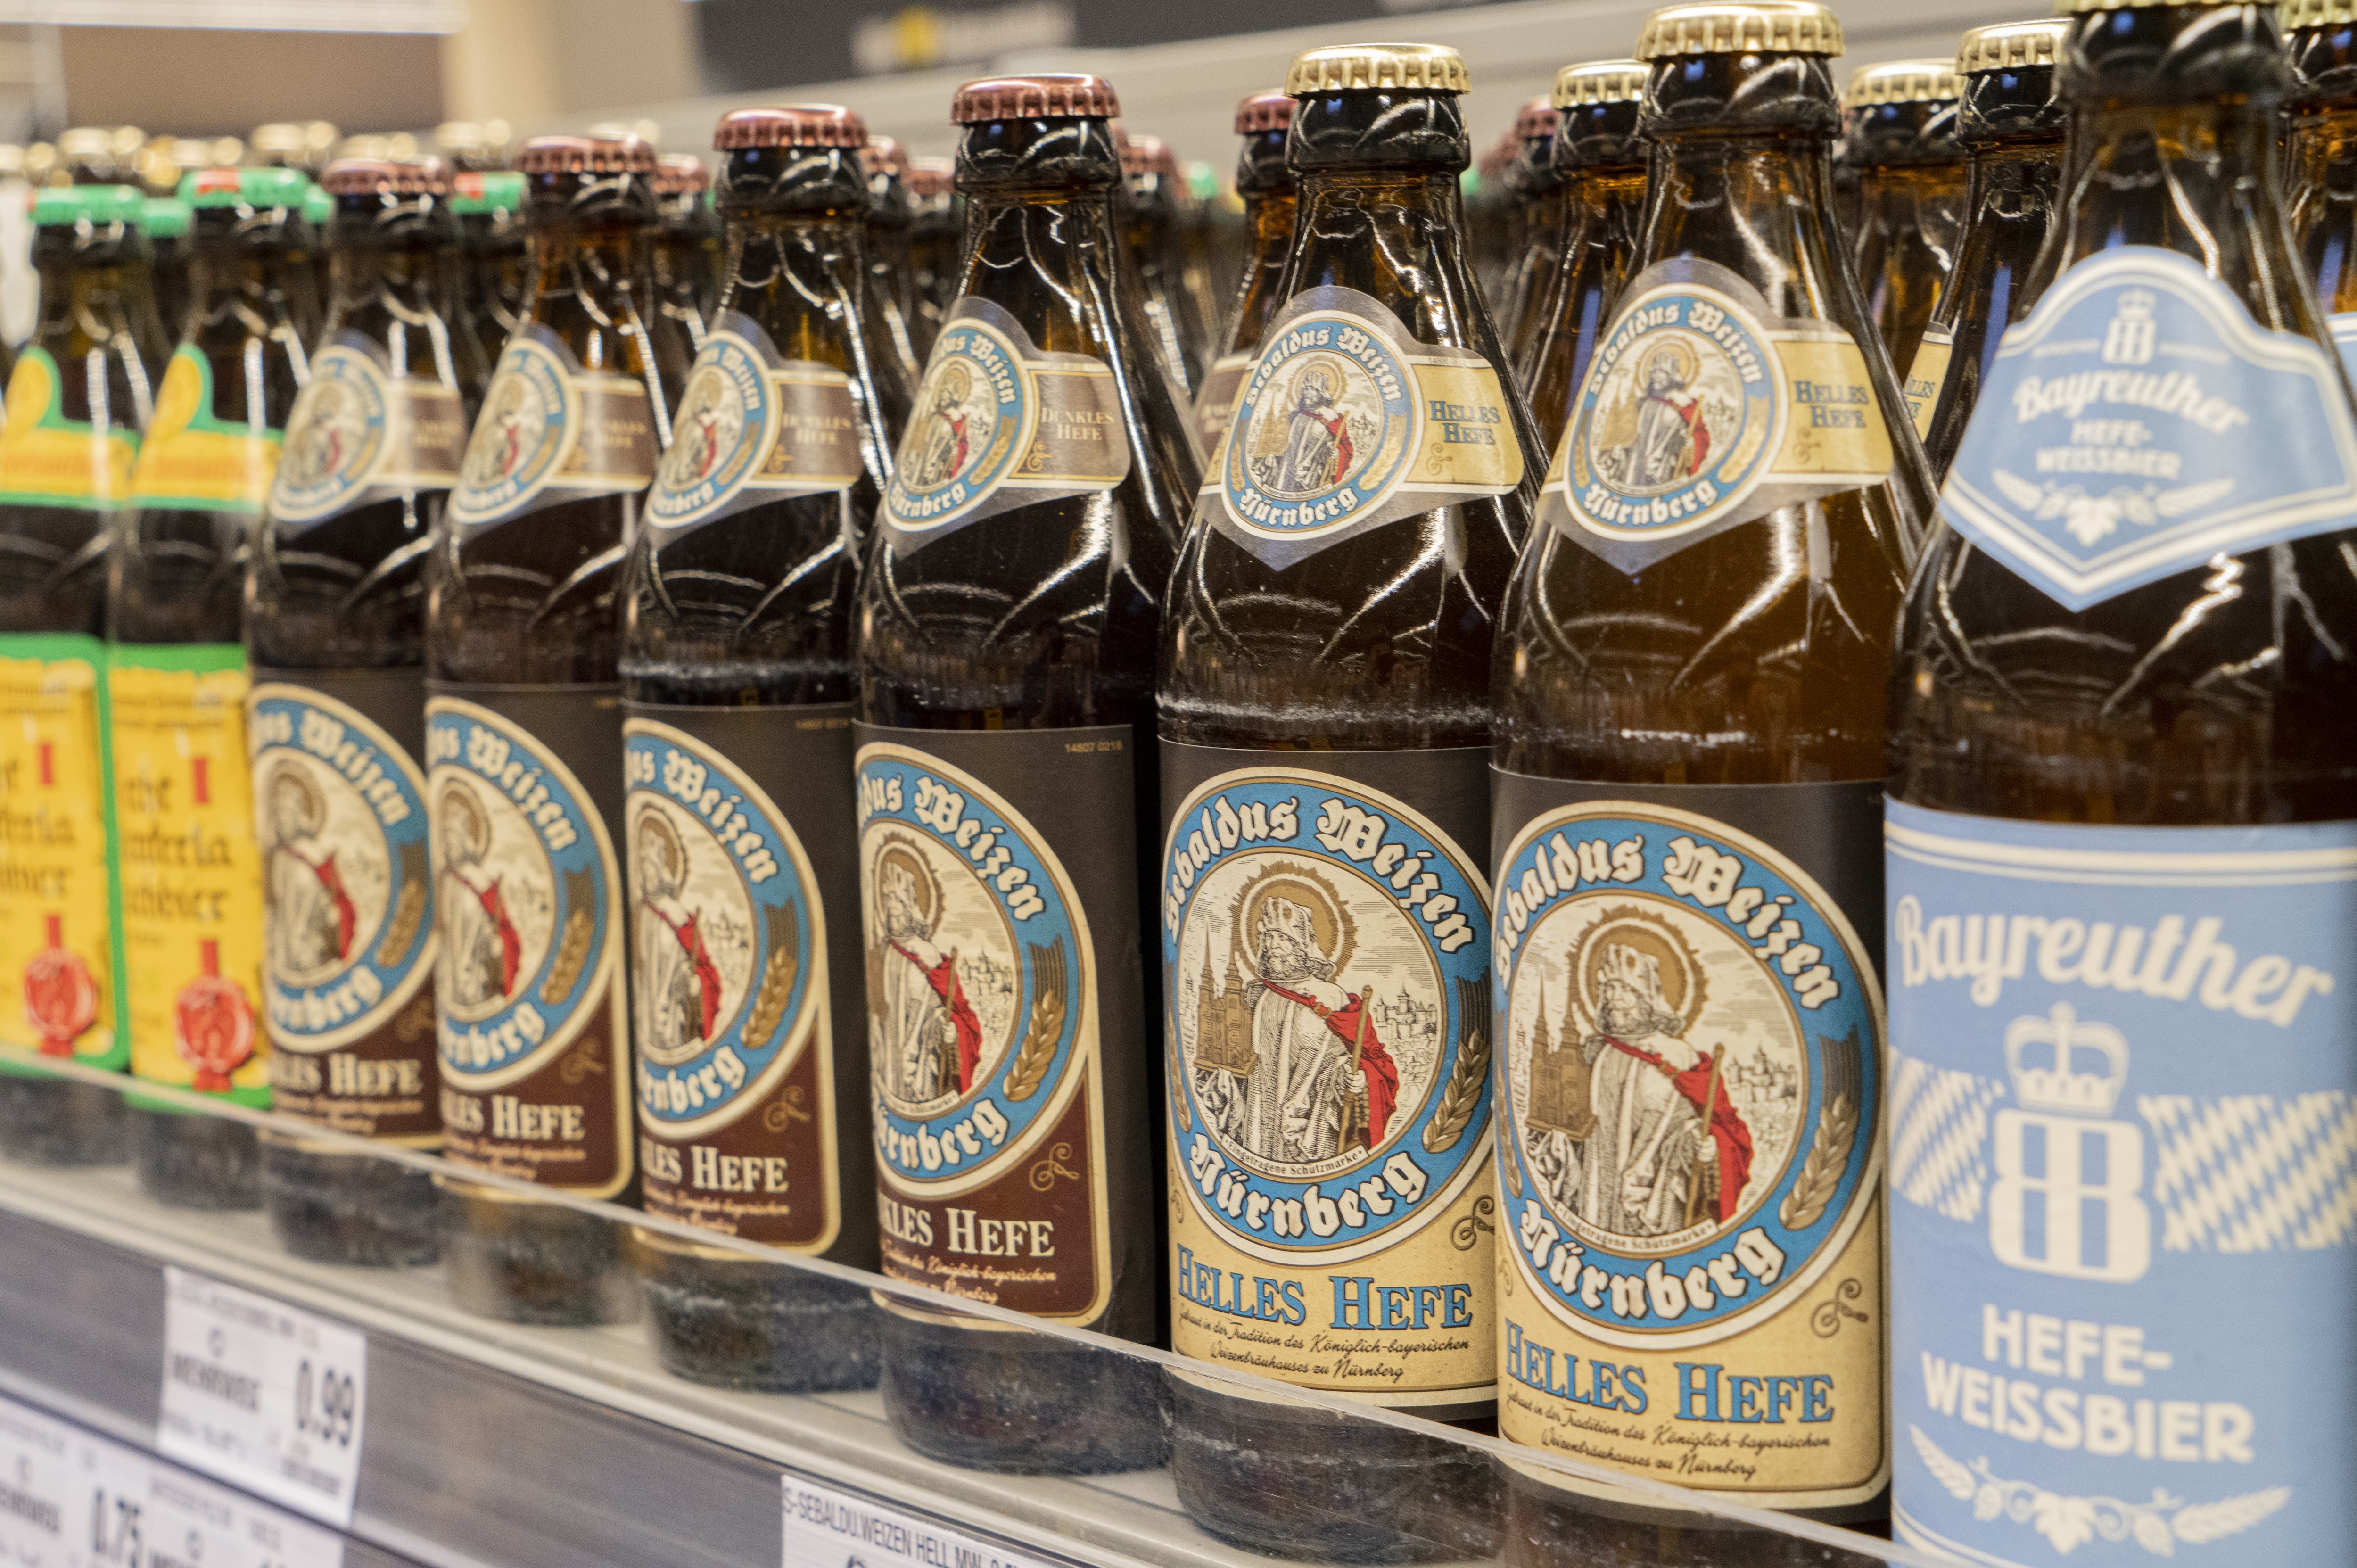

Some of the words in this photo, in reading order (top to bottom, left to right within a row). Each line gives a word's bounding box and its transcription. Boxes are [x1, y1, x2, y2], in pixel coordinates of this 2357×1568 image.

[970, 334, 1016, 404] Weizen
[1336, 326, 1402, 401] Weizen
[1688, 301, 1763, 383] Weizen
[1429, 401, 1500, 424] HELLES
[1795, 381, 1869, 404] HELLES
[1809, 405, 1866, 428] HEFE
[2013, 371, 2249, 433] Bayreuther
[1057, 424, 1102, 441] HEFE
[1442, 423, 1496, 445] HEFE
[1238, 487, 1359, 527] Nürnberg
[1584, 479, 1718, 524] Nürnberg
[664, 749, 778, 883] Weizen
[914, 776, 1045, 921] Weizen
[1165, 795, 1299, 943] Sebaldus
[1315, 798, 1475, 954] Weizen
[1662, 835, 1841, 1010] Weizen
[1895, 894, 2334, 1028] Bayreuther
[492, 1094, 584, 1141] HEFE
[691, 1145, 789, 1193] HEFE
[1189, 1132, 1430, 1238] Nürnberg
[1228, 1141, 1286, 1173] Eingetragene
[1290, 1153, 1357, 1175] Schutzmarke
[946, 1207, 1055, 1257] HEFE
[1520, 1199, 1787, 1320] Nürnberg
[1178, 1244, 1306, 1326] HELLES
[1329, 1275, 1473, 1330] HEFE
[1227, 1322, 1281, 1346] Tradition
[1284, 1334, 1304, 1349] des
[1983, 1303, 2173, 1386] HEFE-
[1313, 1364, 1330, 1375] zu
[1333, 1358, 1404, 1383] Nürnberg
[1505, 1318, 1648, 1415] HELLES
[1674, 1362, 1834, 1424] HEFE
[1561, 1408, 1620, 1436] Tradition
[1921, 1350, 2254, 1464] WEISSBIER
[916, 1533, 950, 1568] HELL
